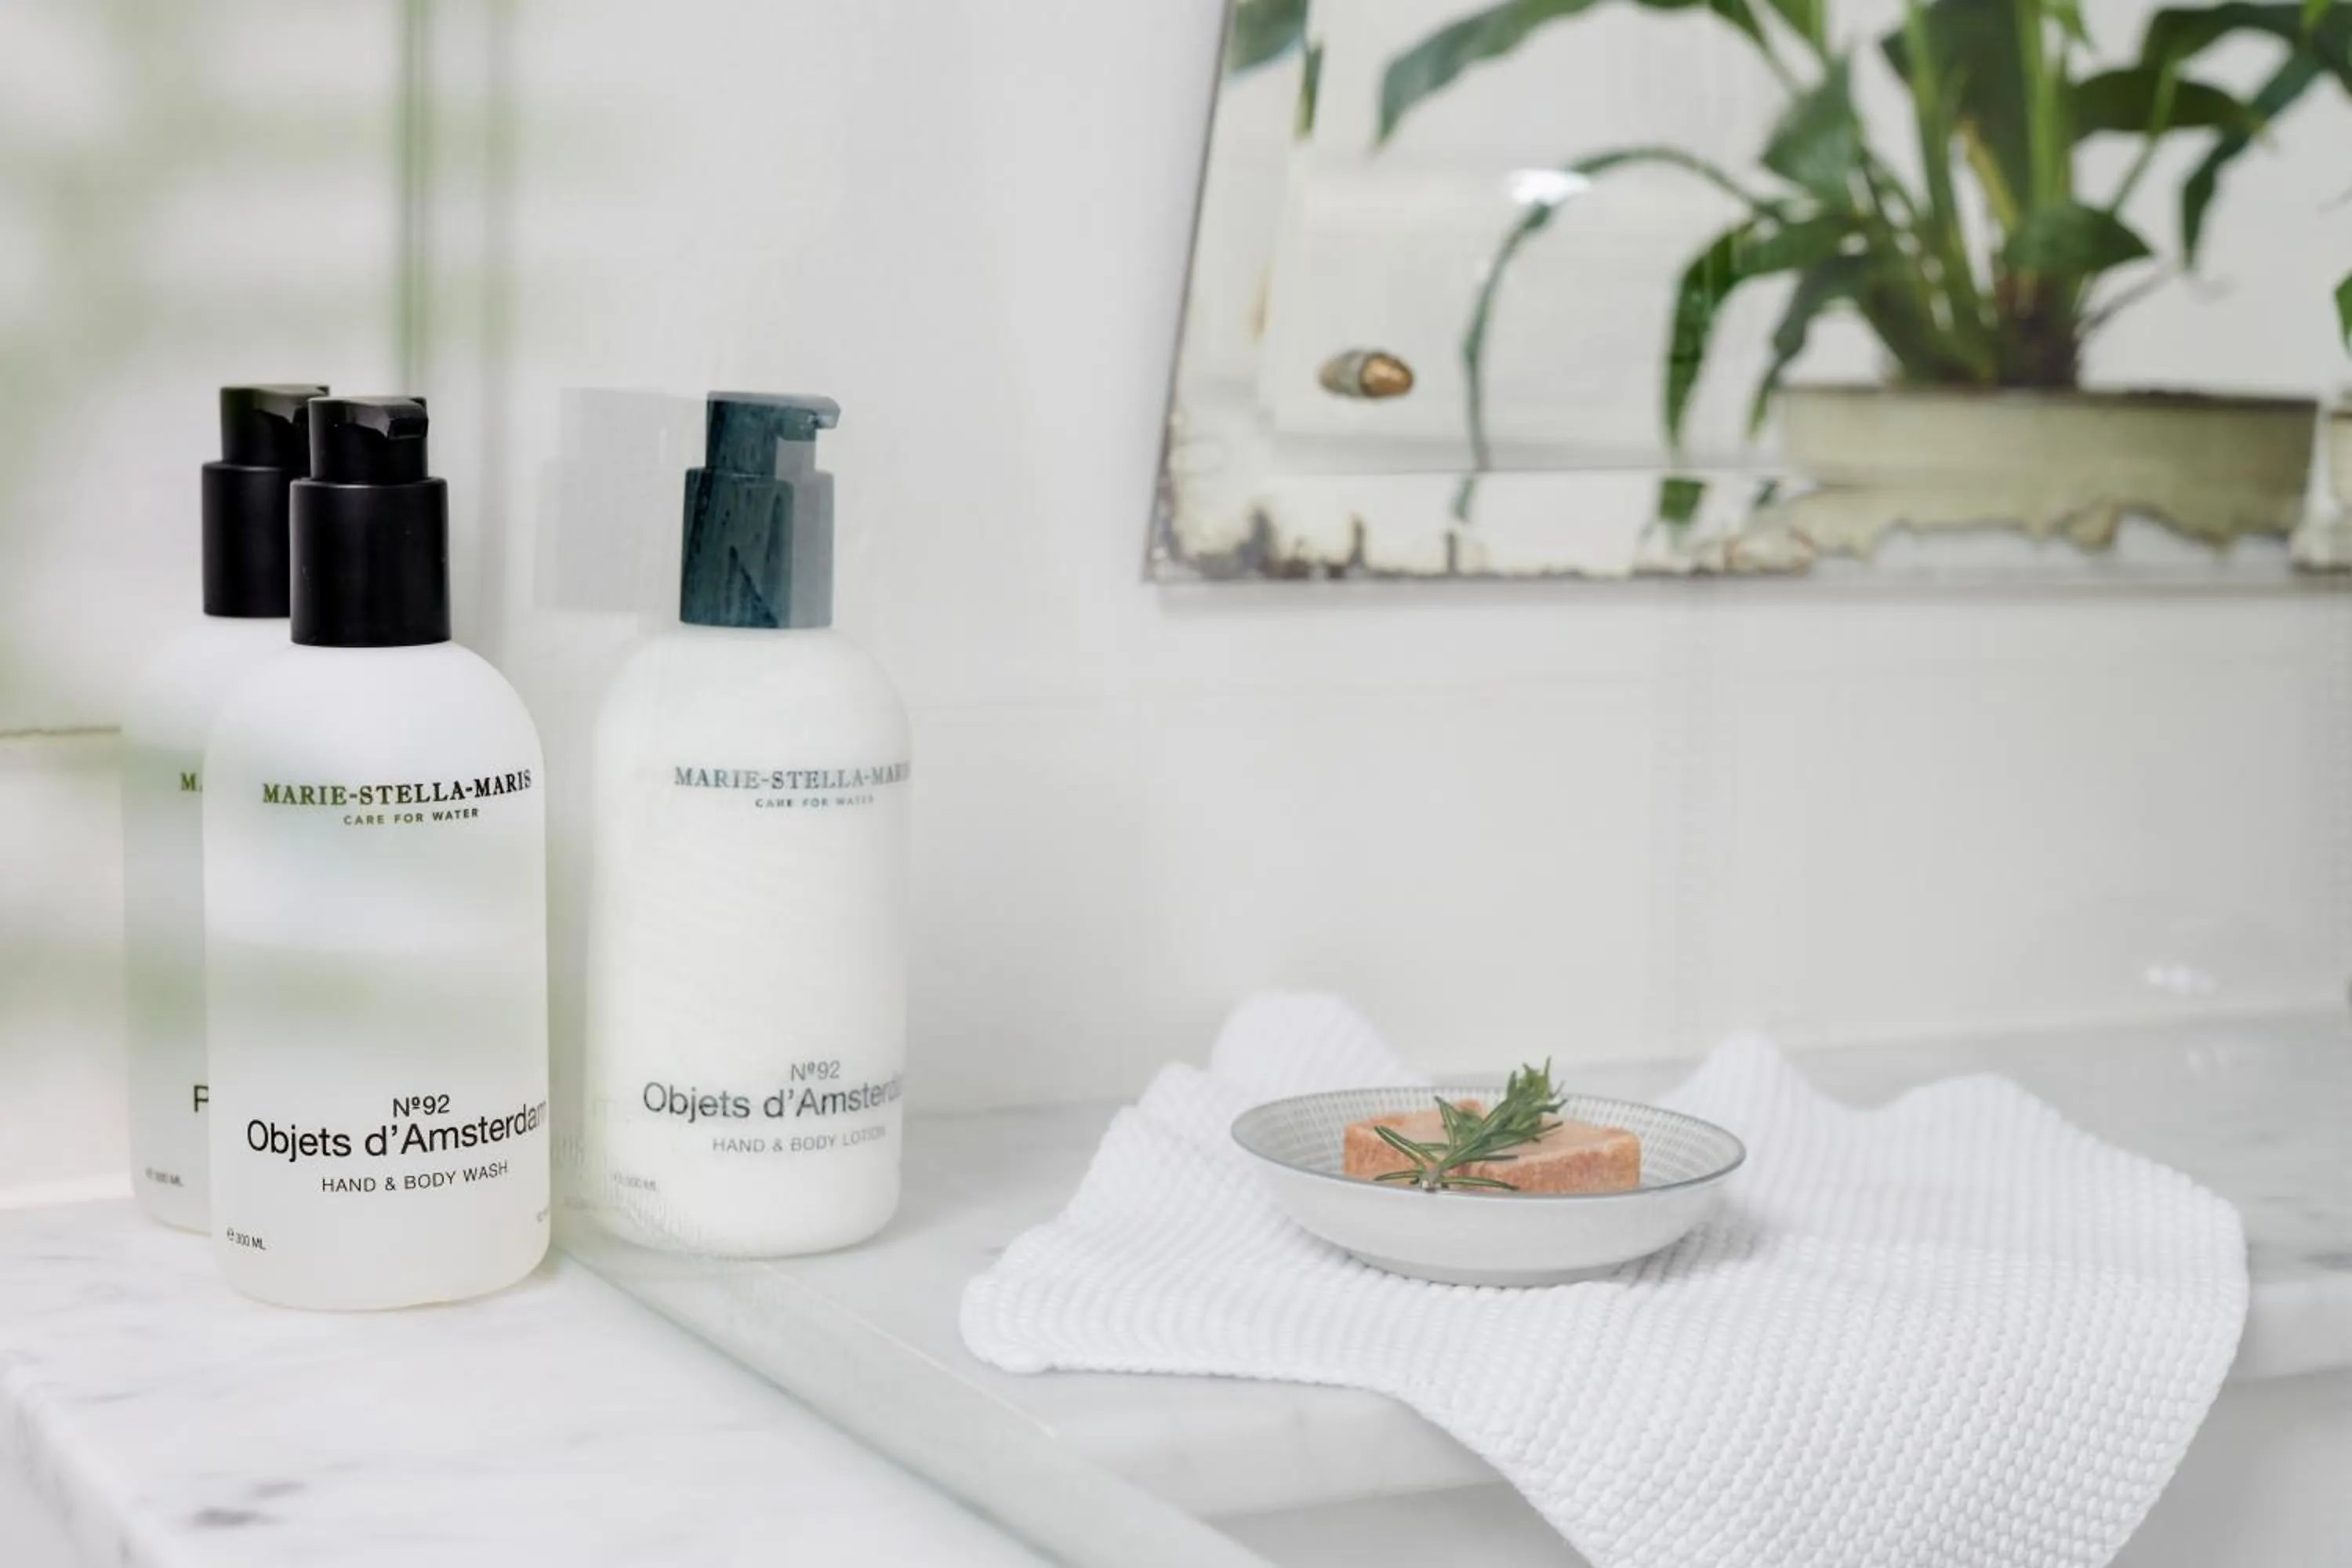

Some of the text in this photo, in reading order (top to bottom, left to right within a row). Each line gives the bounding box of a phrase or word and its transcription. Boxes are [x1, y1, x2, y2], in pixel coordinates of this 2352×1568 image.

[263, 769, 532, 805] MARIE-STELLA-MARIS
[343, 808, 480, 826] CARE FOR WATER
[643, 1082, 751, 1123] Objets
[247, 1119, 352, 1163] Objets
[712, 1138, 766, 1153] HAND
[771, 1137, 784, 1153] &
[789, 1134, 837, 1153] BODY
[321, 1160, 509, 1192] HAND & BODY WASH
